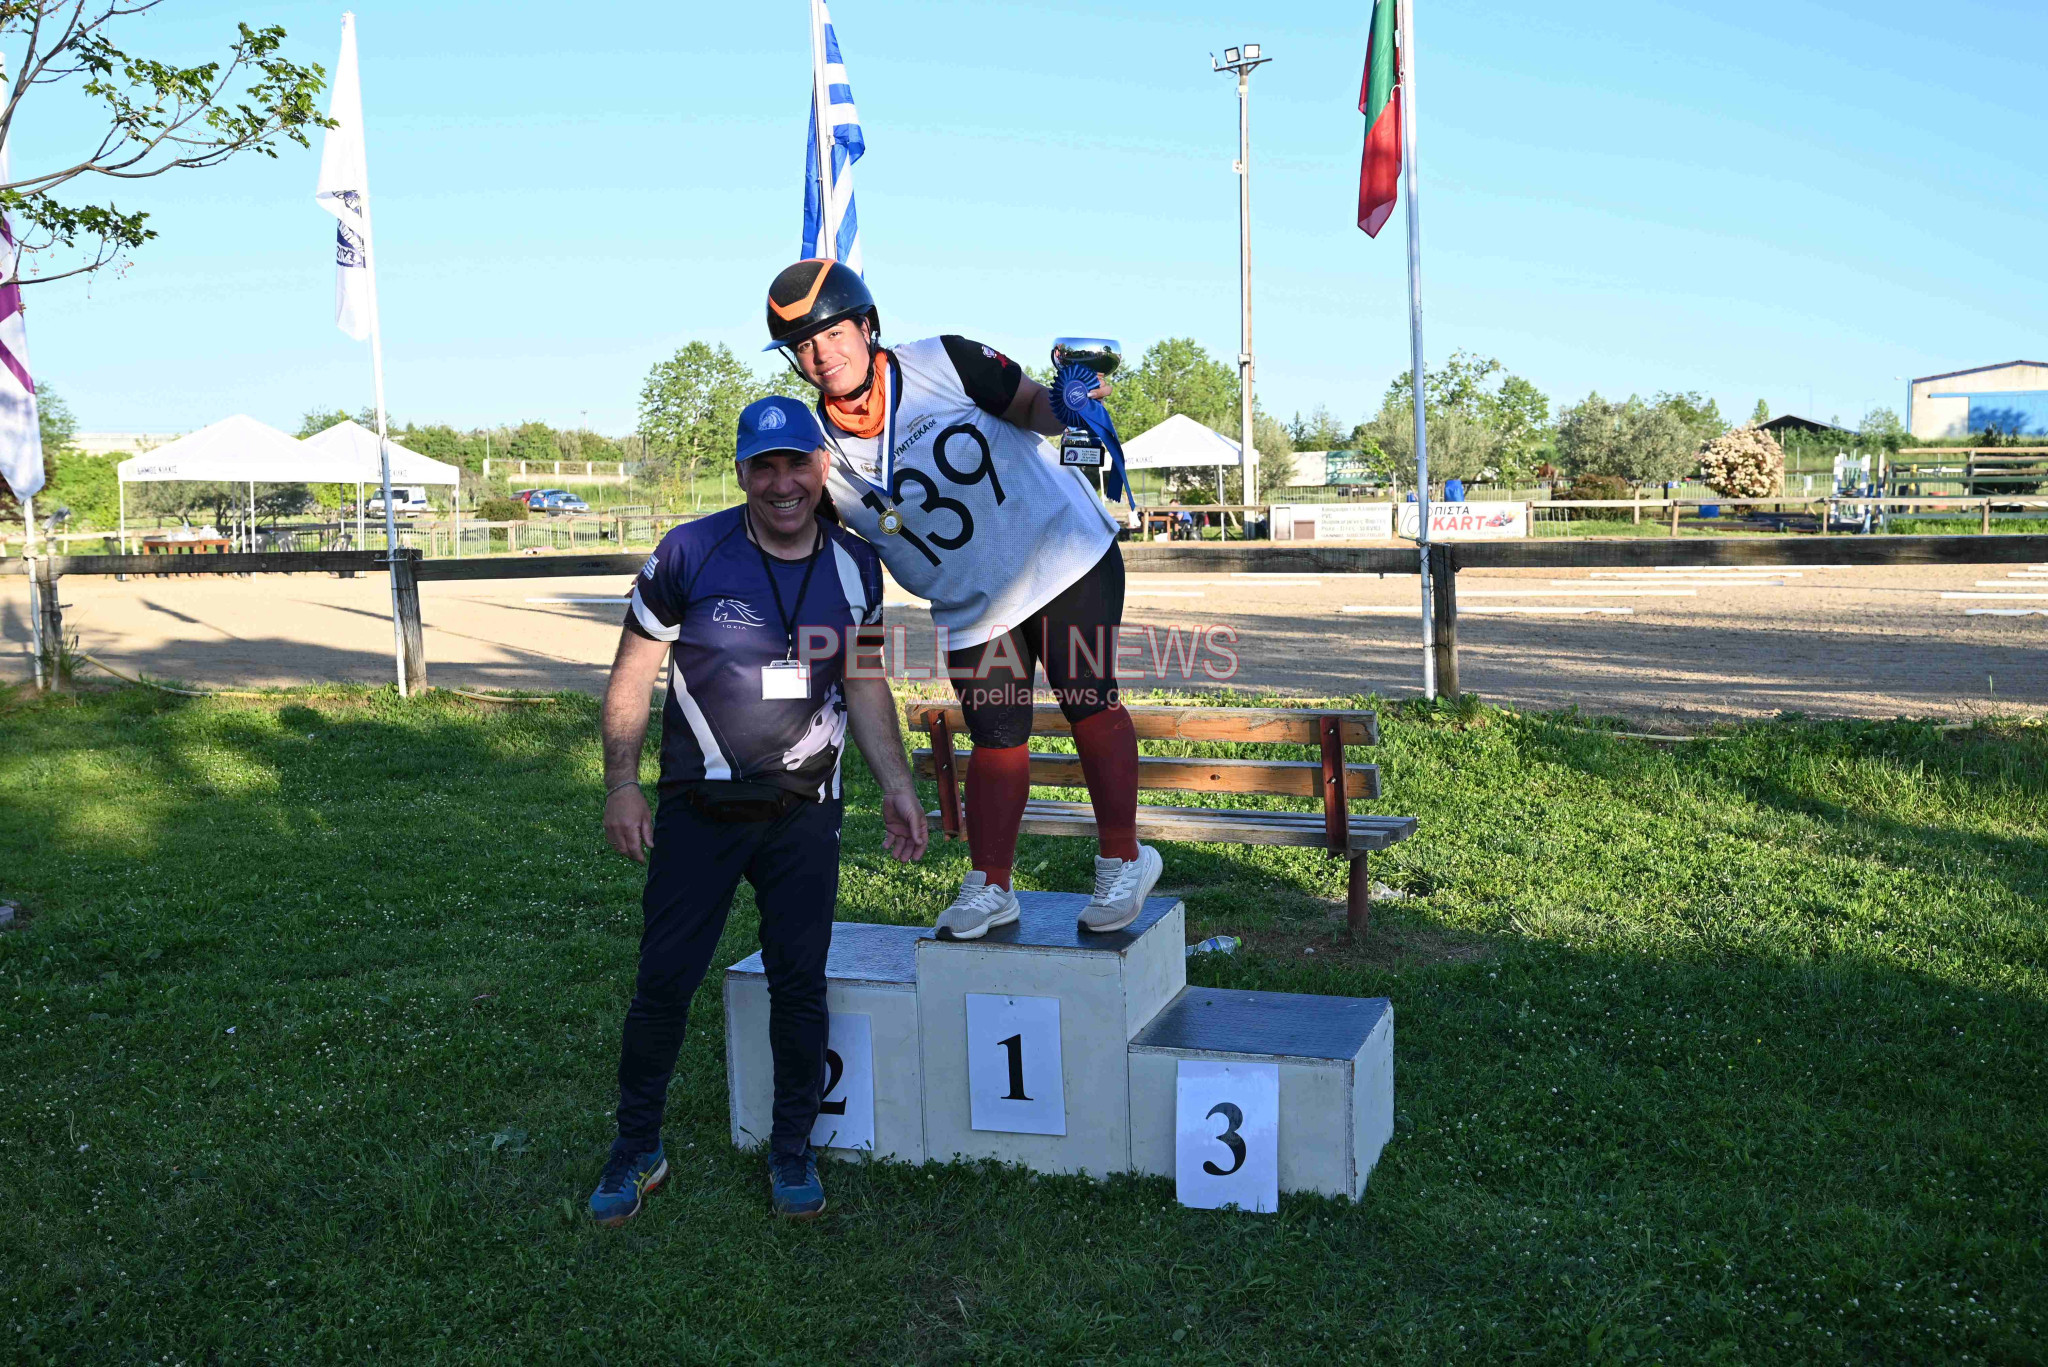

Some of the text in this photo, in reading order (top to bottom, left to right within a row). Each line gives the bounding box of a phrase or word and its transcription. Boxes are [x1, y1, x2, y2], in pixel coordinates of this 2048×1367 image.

[861, 423, 1006, 567] 139
[1432, 516, 1487, 531] KART
[1435, 506, 1470, 515] ΠΙΣΤΑ
[819, 1048, 848, 1116] 2
[997, 1033, 1034, 1101] 1
[1202, 1102, 1247, 1176] 3
